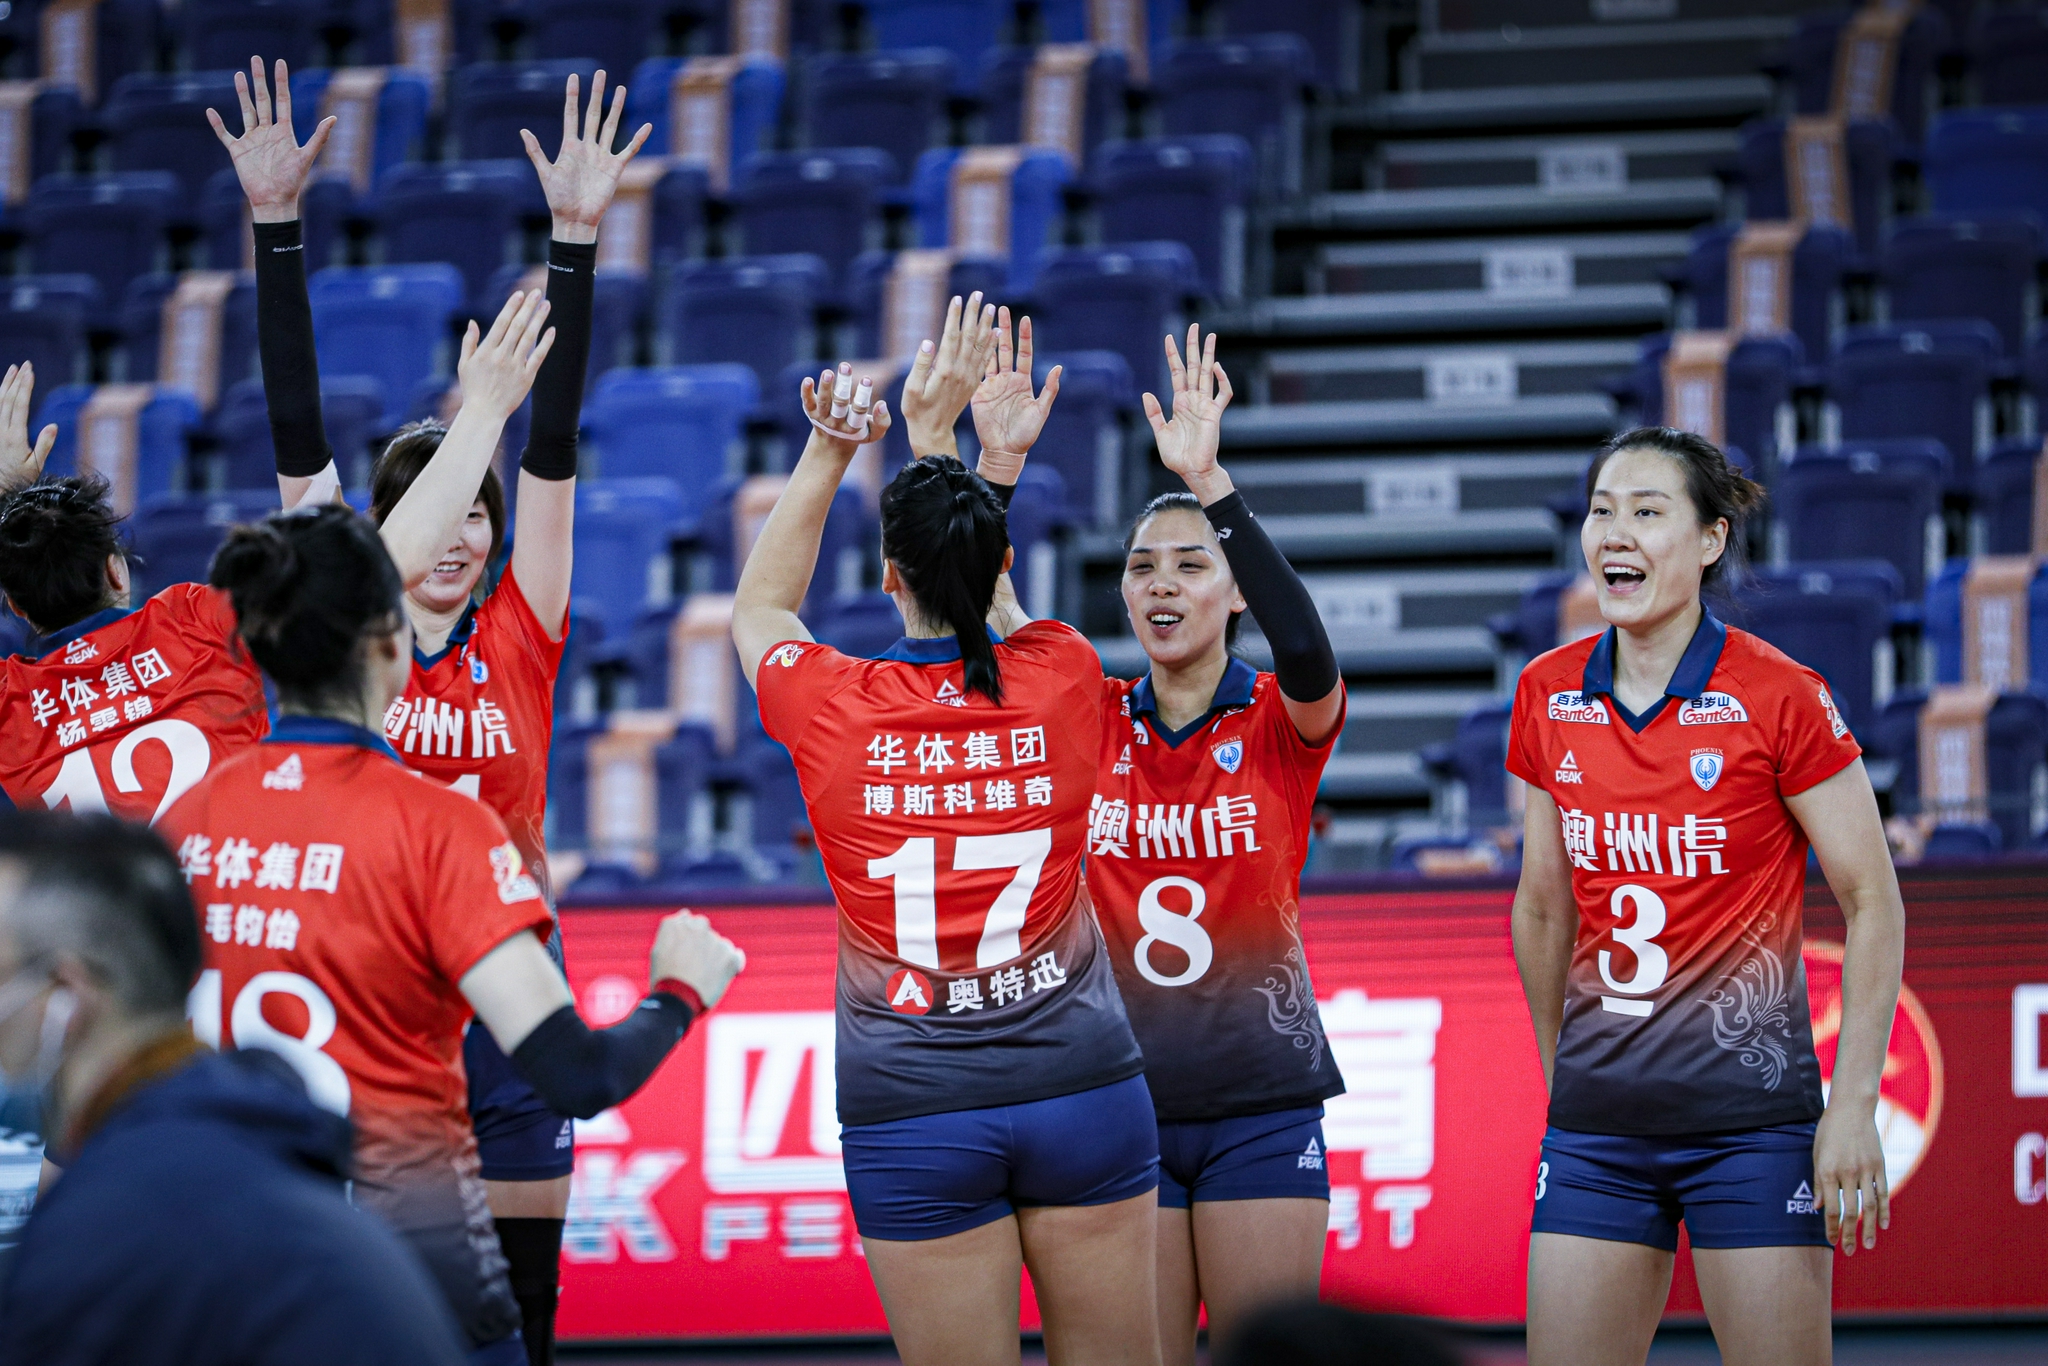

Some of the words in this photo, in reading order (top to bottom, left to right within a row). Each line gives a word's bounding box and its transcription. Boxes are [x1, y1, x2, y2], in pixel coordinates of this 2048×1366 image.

[31, 648, 172, 727] 华体集团
[1691, 695, 1730, 708] 百岁山
[866, 725, 1046, 775] 华体集团
[1209, 734, 1242, 751] PHOENIX
[1690, 748, 1724, 756] PHOENIX
[863, 776, 1053, 815] 博斯科维奇
[1555, 770, 1584, 784] PEAK
[1087, 793, 1261, 859] 澳洲虎
[1558, 805, 1730, 878] 澳洲虎
[178, 833, 345, 894] 华体集团
[867, 826, 1052, 970] 17
[1133, 875, 1213, 987] 8
[1598, 884, 1668, 994] 3
[946, 950, 1067, 1014] 奥特迅
[184, 968, 351, 1118] 18
[1297, 1155, 1324, 1170] PEAK
[1534, 1161, 1549, 1201] 3
